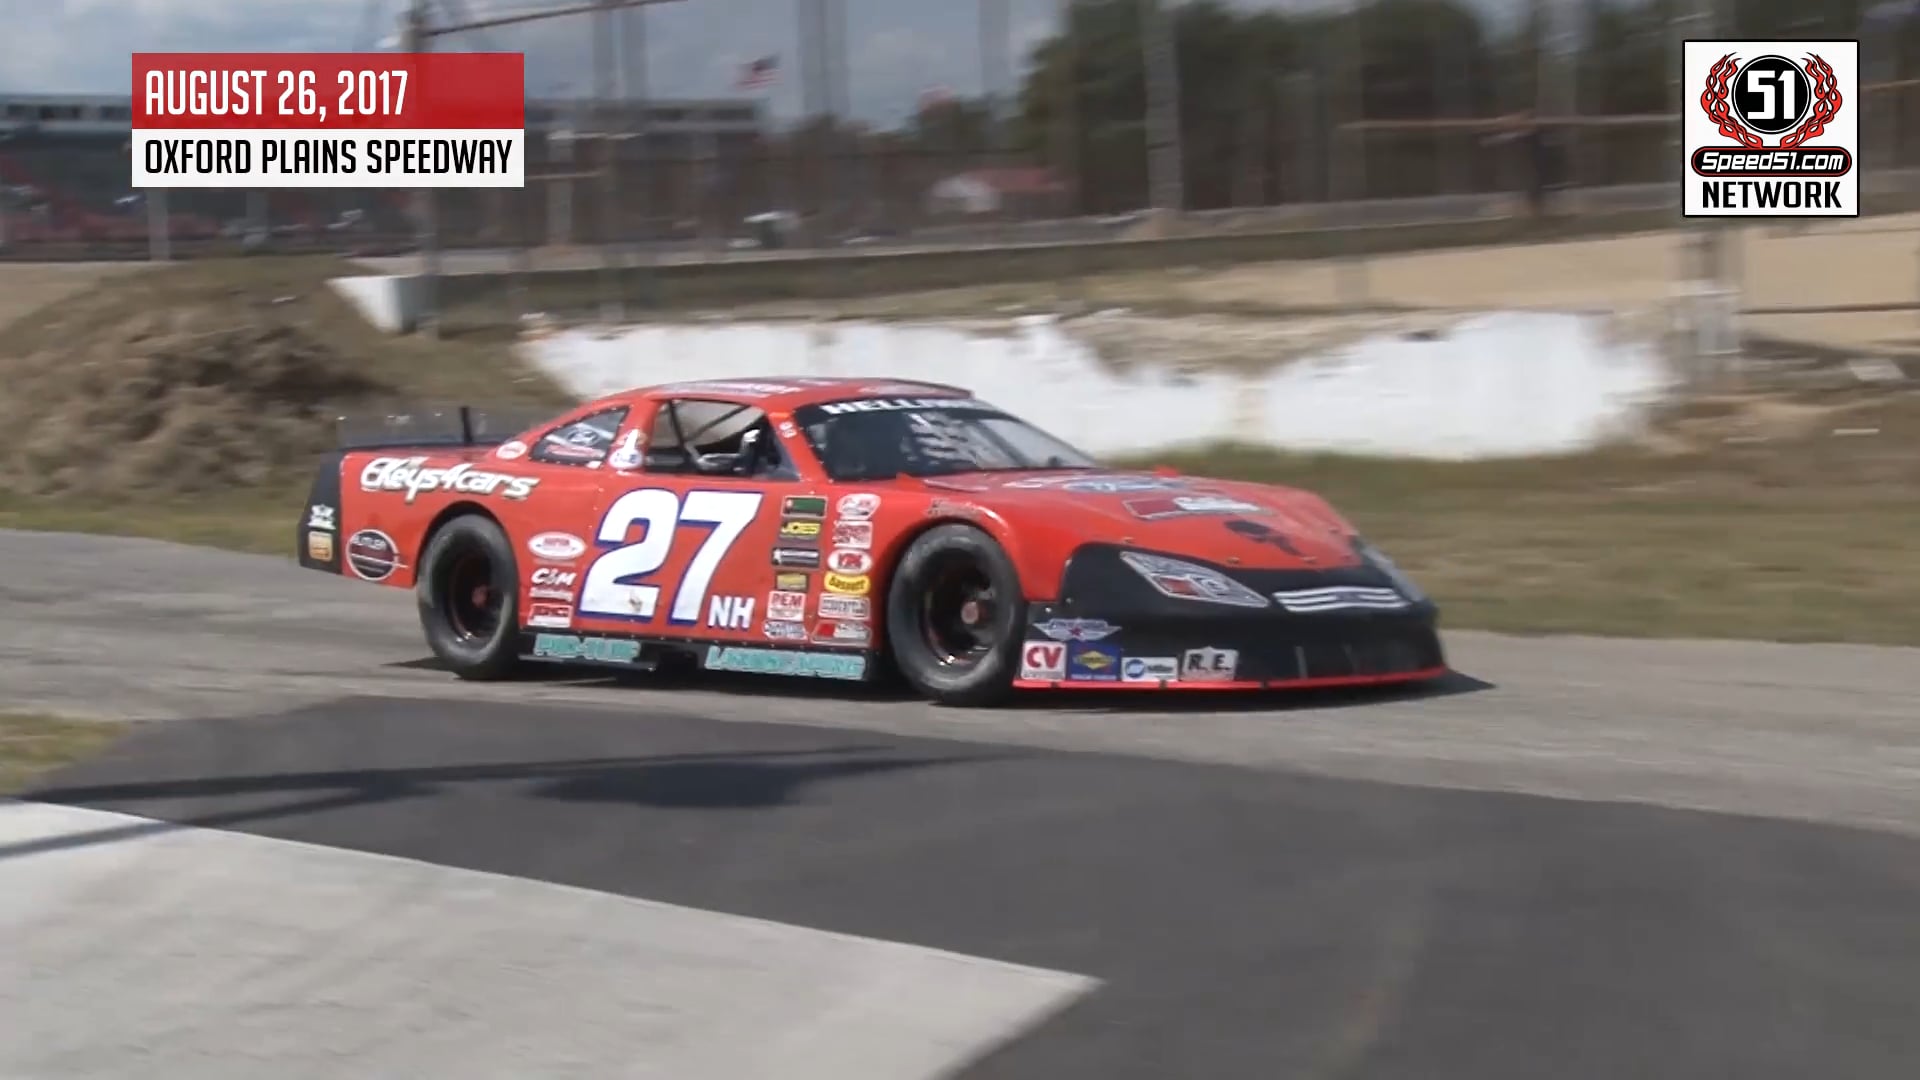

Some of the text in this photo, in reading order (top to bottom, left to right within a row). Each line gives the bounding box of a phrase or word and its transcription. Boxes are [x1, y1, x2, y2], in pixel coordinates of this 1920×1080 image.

[576, 486, 766, 626] 27
[707, 594, 756, 629] NH
[771, 593, 803, 608] PEM
[1026, 646, 1062, 669] CV
